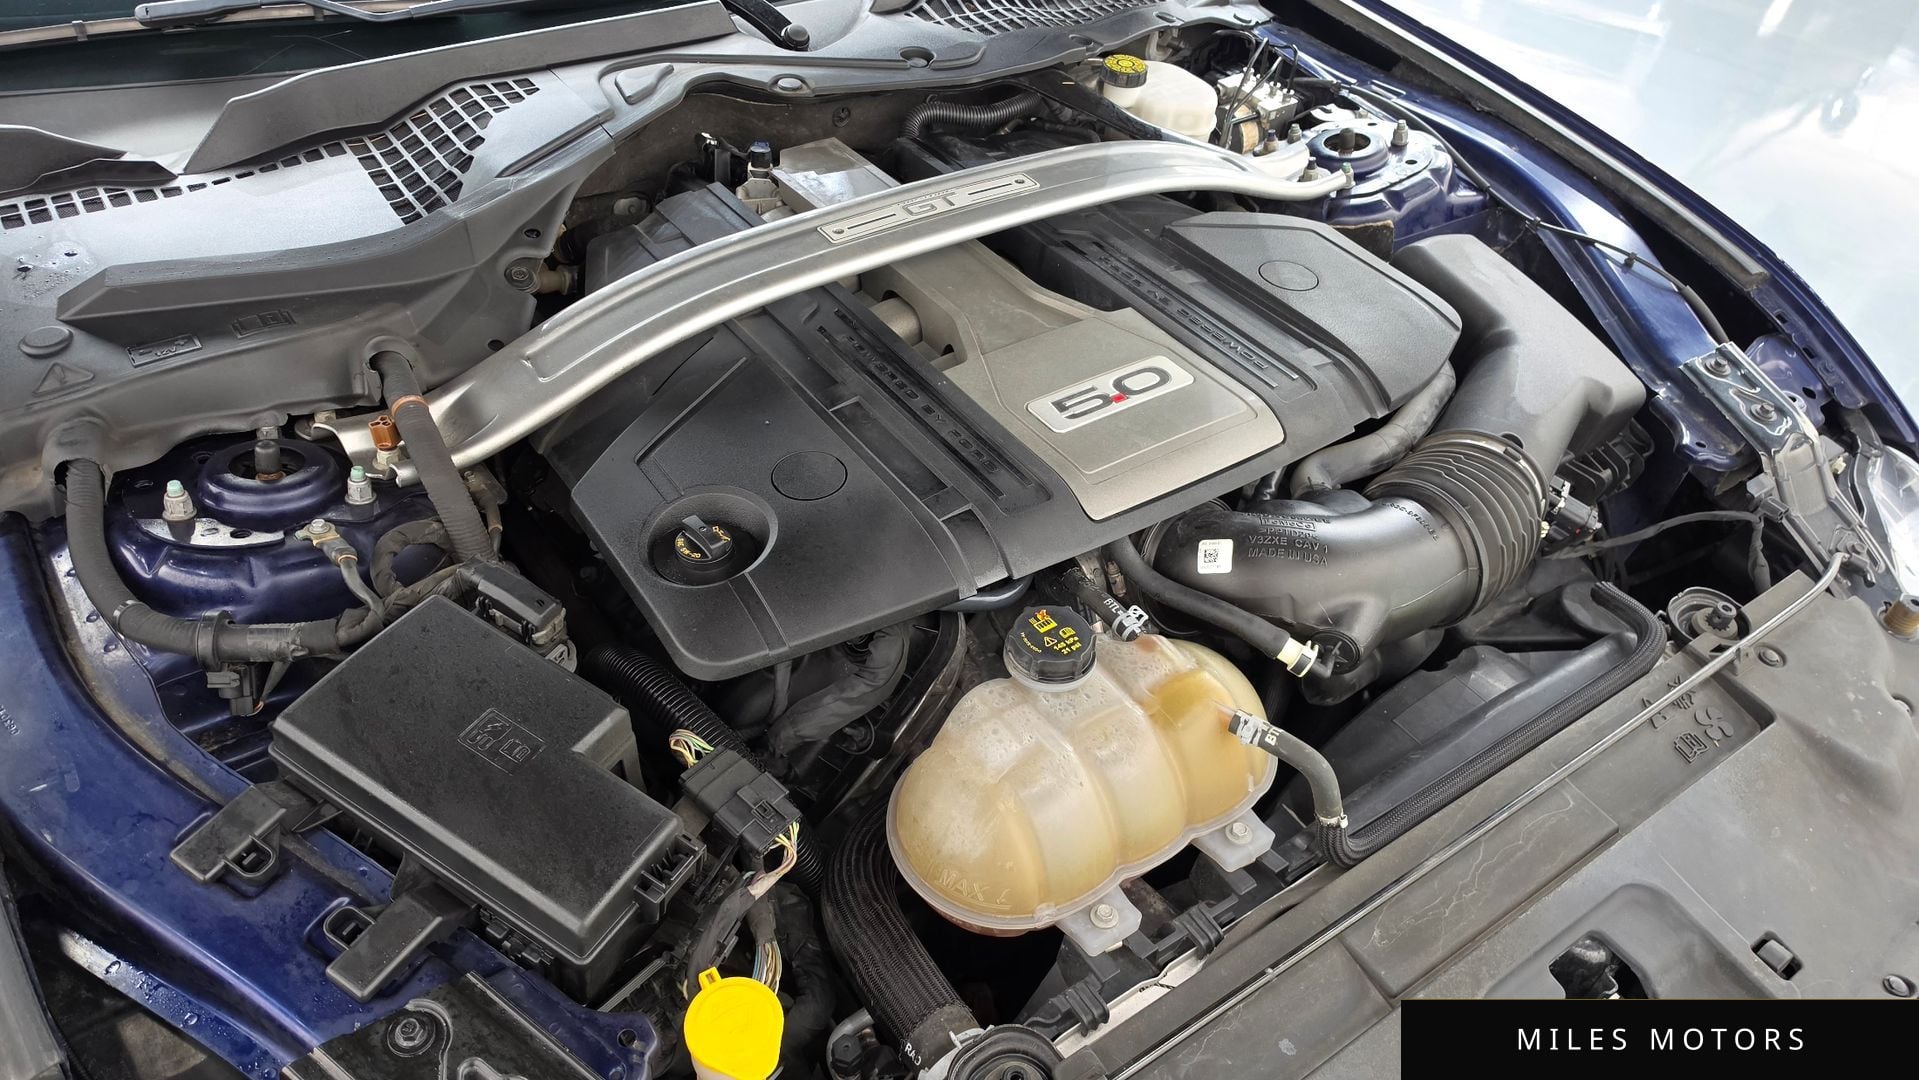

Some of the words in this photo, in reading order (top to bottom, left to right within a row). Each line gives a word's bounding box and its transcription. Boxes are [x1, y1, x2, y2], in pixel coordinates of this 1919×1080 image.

[902, 192, 957, 216] GT
[1050, 366, 1171, 420] 5.0
[1295, 538, 1320, 551] CAV
[1248, 547, 1286, 559] MADE
[1288, 549, 1301, 561] IN
[1304, 552, 1328, 567] USA
[940, 868, 990, 902] MAX
